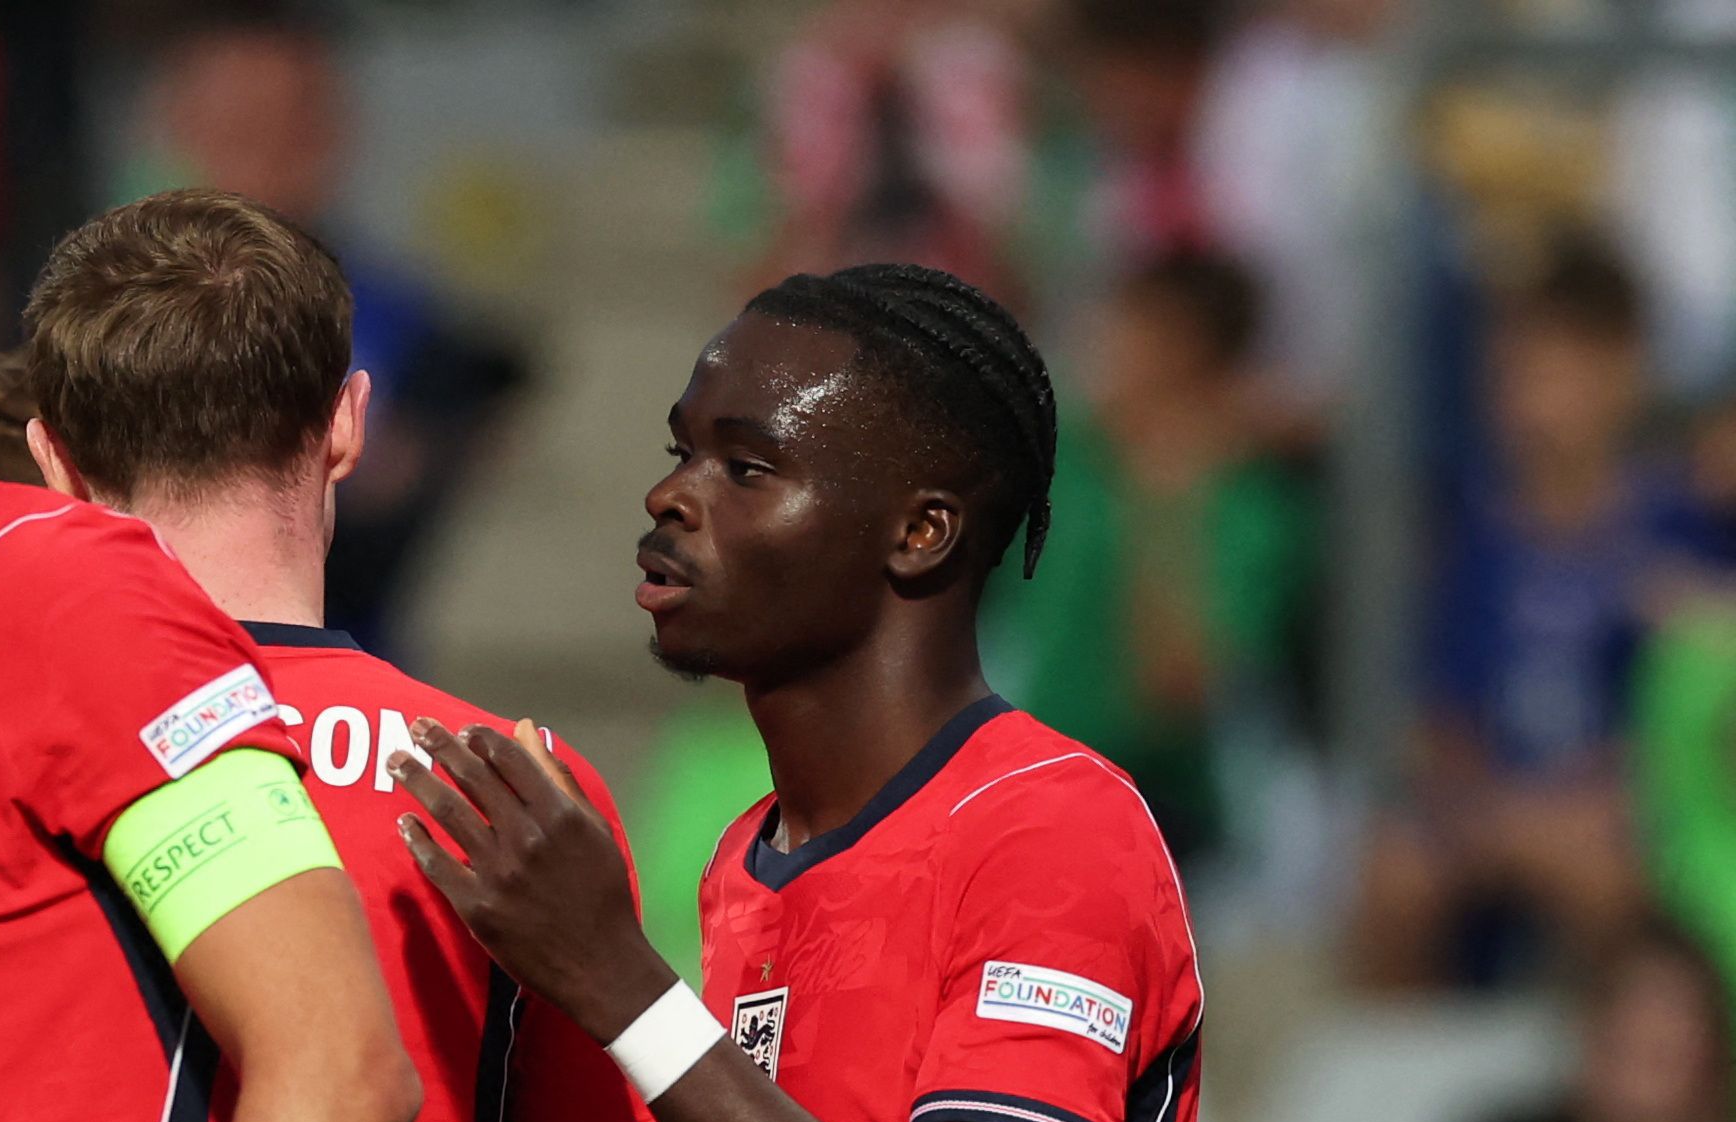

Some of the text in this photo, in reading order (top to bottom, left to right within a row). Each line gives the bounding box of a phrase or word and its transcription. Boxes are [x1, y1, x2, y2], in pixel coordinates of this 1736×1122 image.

[276, 703, 434, 793] ON
[131, 808, 235, 903] RESPECT
[984, 979, 1127, 1034] FOUNDATION
[988, 965, 1022, 980] UEFA
